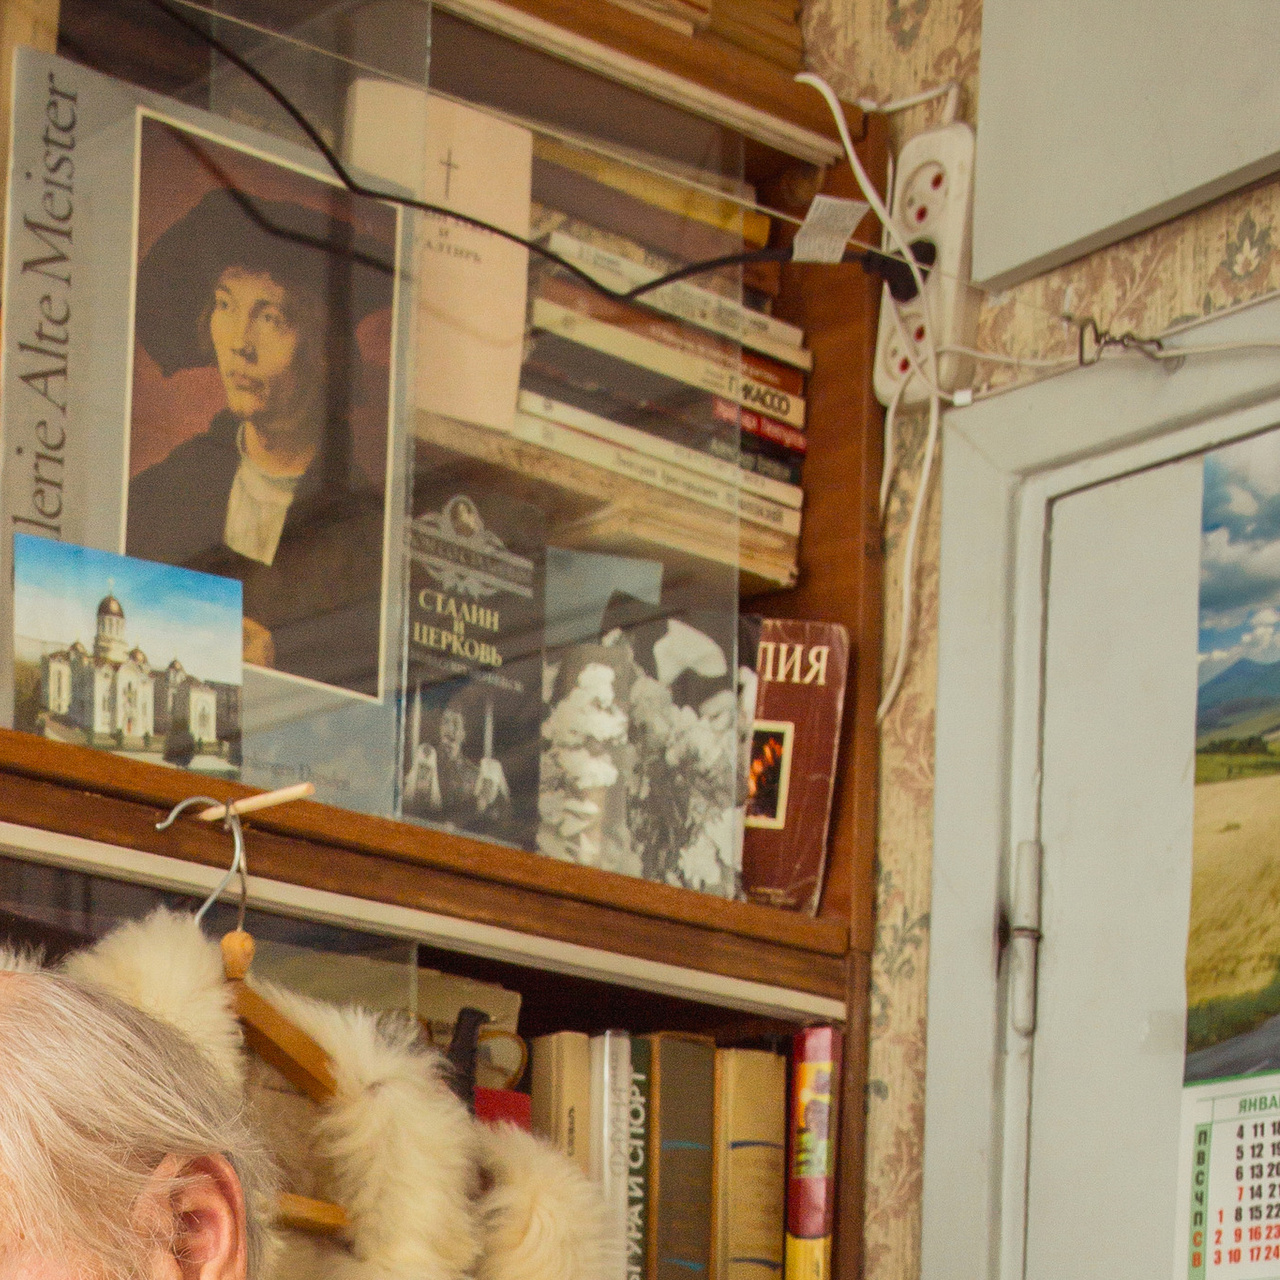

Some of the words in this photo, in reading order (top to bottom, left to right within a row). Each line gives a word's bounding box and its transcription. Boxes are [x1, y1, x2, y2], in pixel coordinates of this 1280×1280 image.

[23, 72, 78, 287] Meister
[18, 294, 70, 412] Alte
[419, 589, 500, 633] СТАЛИН
[453, 617, 466, 637] И
[413, 621, 503, 667] ЦЕРКОВЬ
[628, 1068, 647, 1168] СПОРТ
[1198, 1130, 1208, 1145] П
[1237, 1125, 1244, 1140] 4
[1253, 1122, 1264, 1138] 11
[1236, 1145, 1243, 1160] 5
[1251, 1143, 1263, 1159] 12
[1195, 1170, 1204, 1186] С
[1236, 1166, 1243, 1181] 6
[1250, 1164, 1262, 1179] 13
[1195, 1190, 1203, 1205] Ч
[1238, 1186, 1244, 1202] 7
[1249, 1184, 1262, 1200] 14
[1194, 1211, 1202, 1226] П
[1218, 1209, 1223, 1224] 1
[1235, 1206, 1242, 1222] 8
[1249, 1205, 1262, 1220] 15
[1266, 1203, 1280, 1218] 22
[1192, 1231, 1202, 1247] С
[1215, 1229, 1222, 1244] 2
[1234, 1228, 1242, 1243] 9
[1248, 1226, 1261, 1241] 16
[1266, 1224, 1280, 1240] 23
[1192, 1252, 1201, 1268] В
[1214, 1250, 1221, 1265] 3
[1228, 1248, 1241, 1264] 10
[1250, 1247, 1261, 1262] 17
[1265, 1245, 1280, 1261] 24
